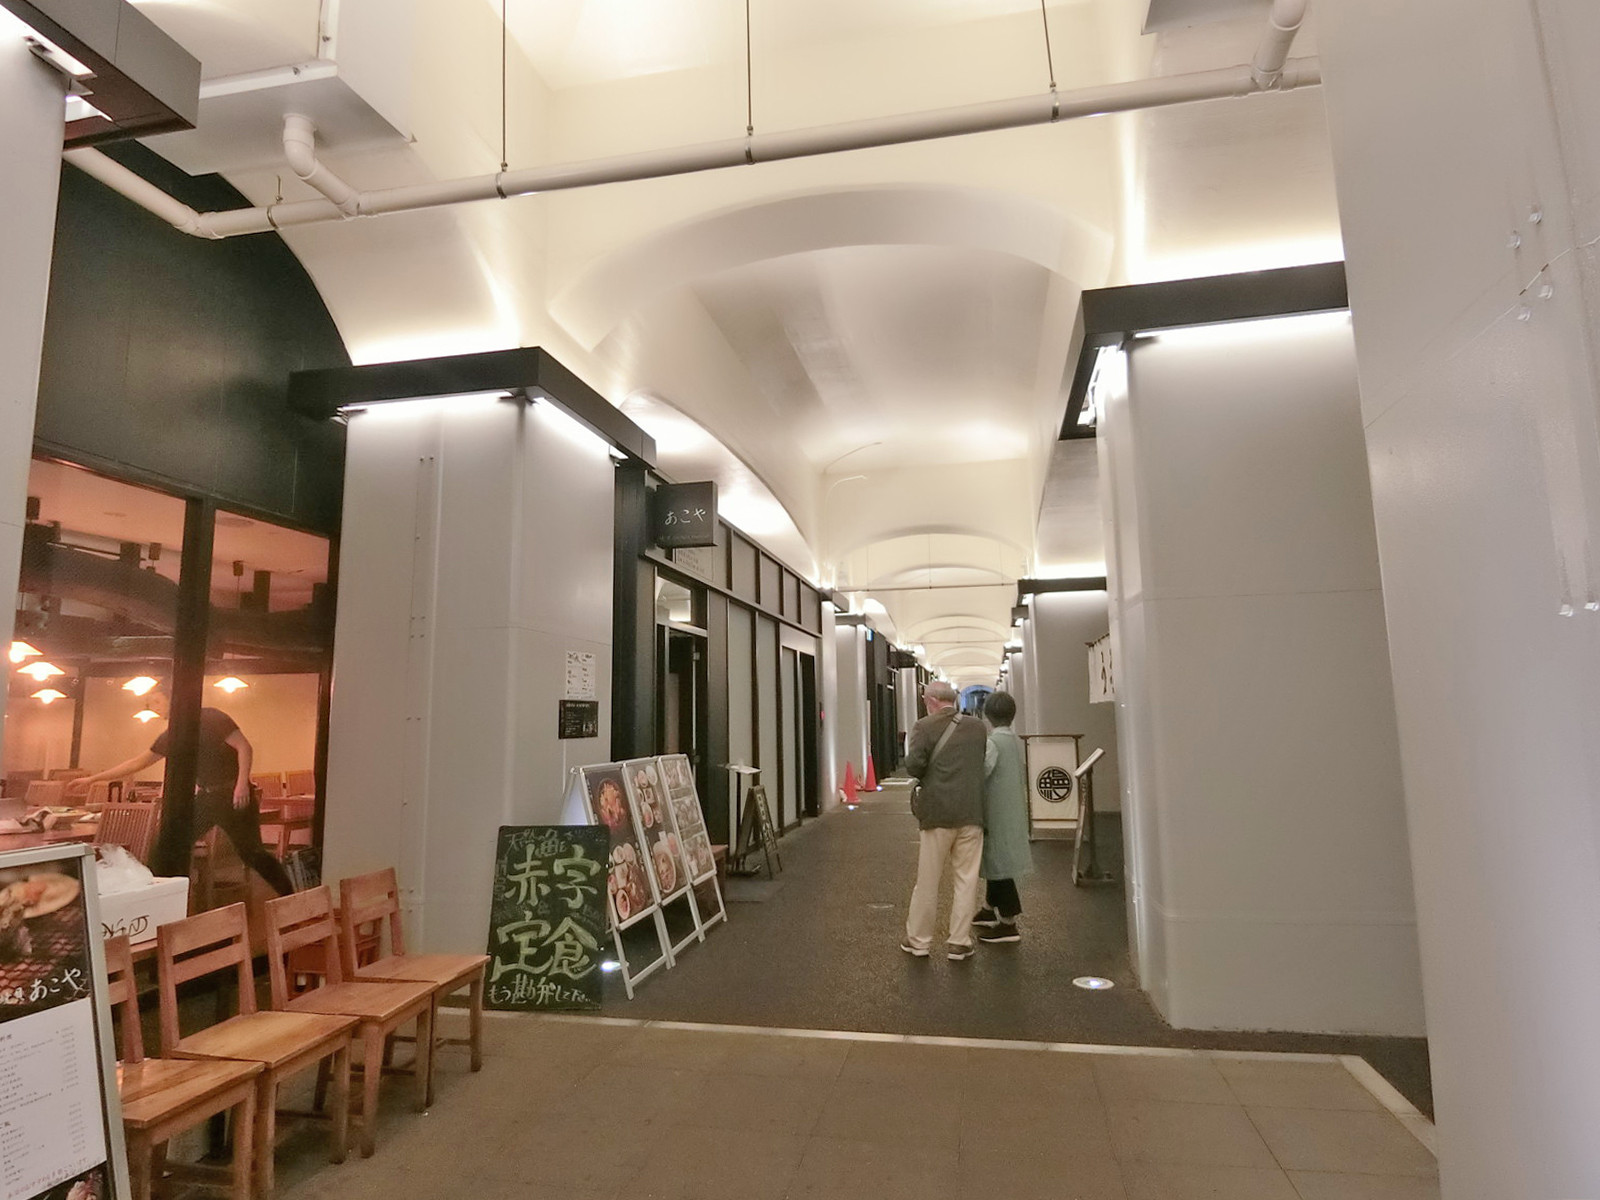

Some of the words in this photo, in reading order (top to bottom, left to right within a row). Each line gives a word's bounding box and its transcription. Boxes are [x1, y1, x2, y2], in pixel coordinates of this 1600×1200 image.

[664, 507, 706, 526] あこや
[503, 843, 602, 910] 赤字
[489, 909, 599, 984] 定食
[29, 967, 82, 1003] あこや
